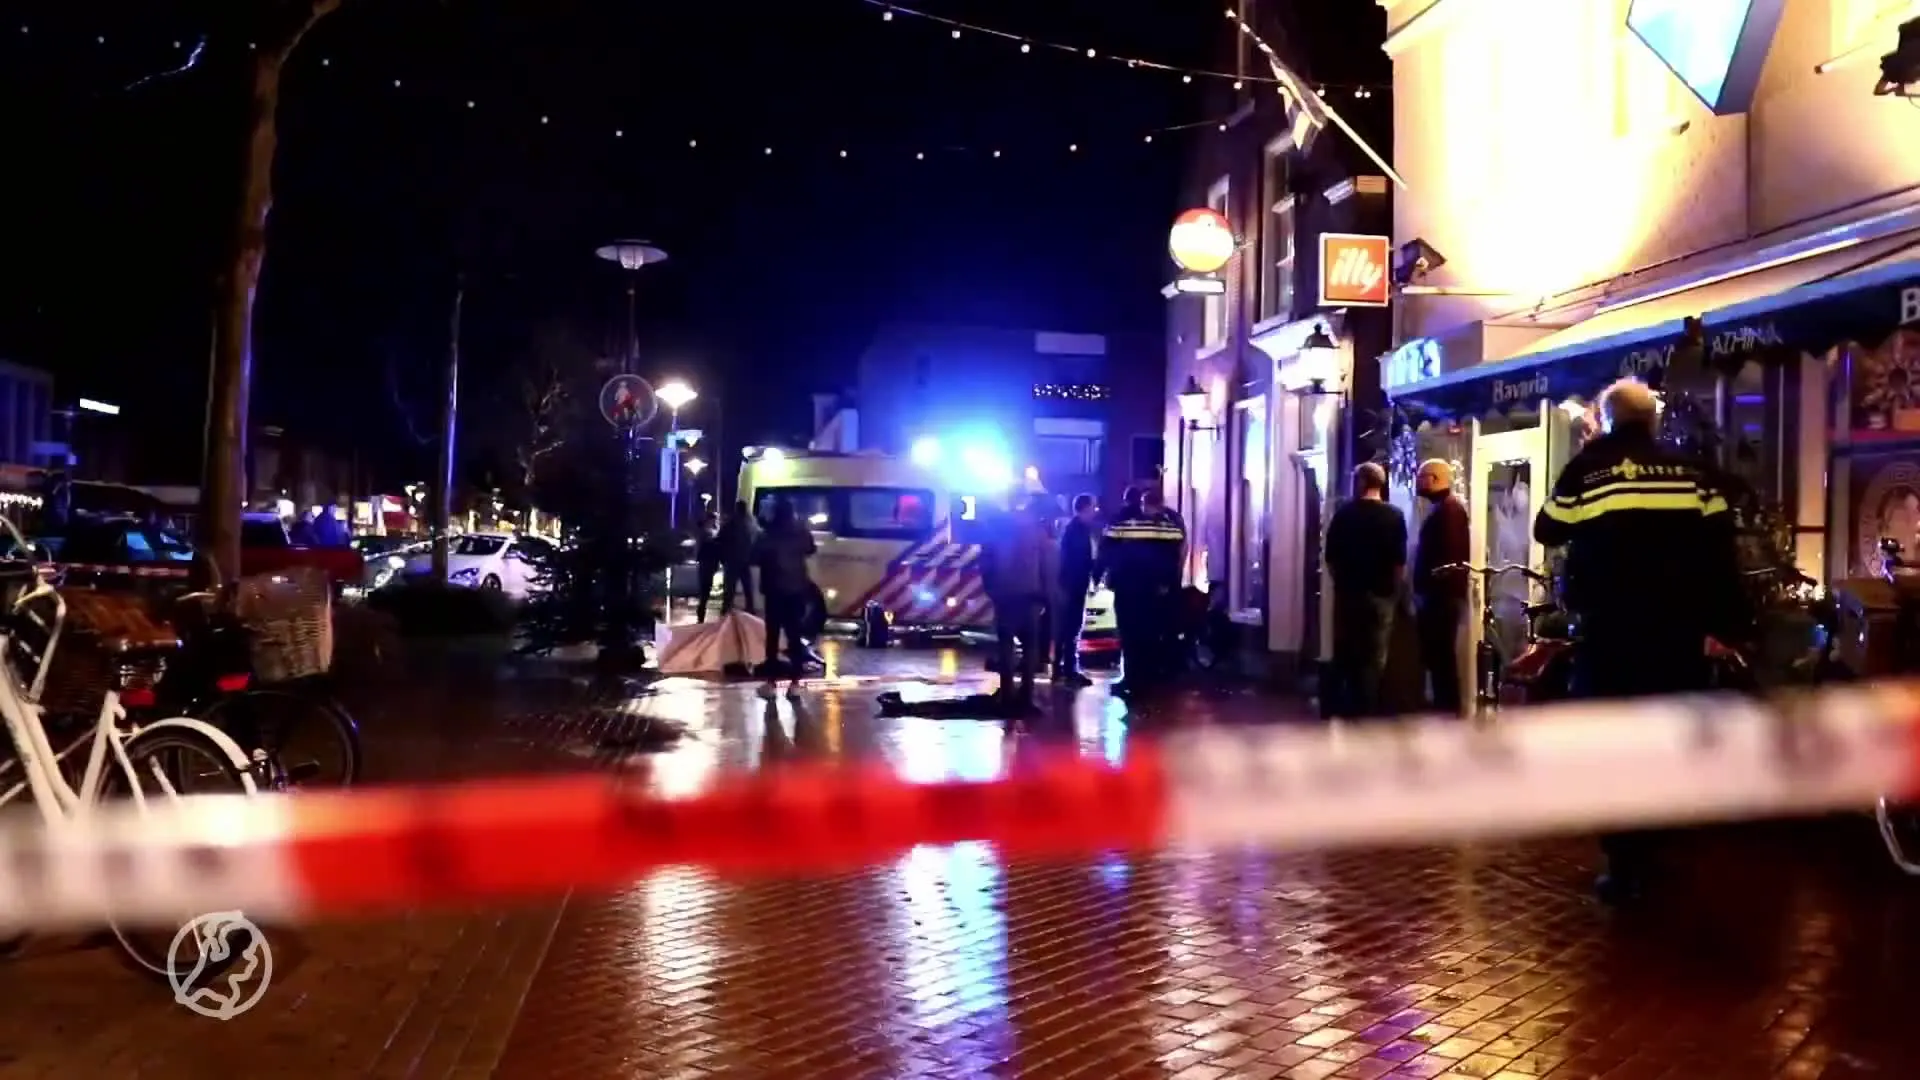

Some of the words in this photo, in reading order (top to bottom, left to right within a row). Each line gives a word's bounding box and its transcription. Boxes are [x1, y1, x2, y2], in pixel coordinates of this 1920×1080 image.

[1330, 248, 1383, 295] illy
[1711, 321, 1784, 355] ATHINA
[1492, 371, 1549, 403] Bavaria
